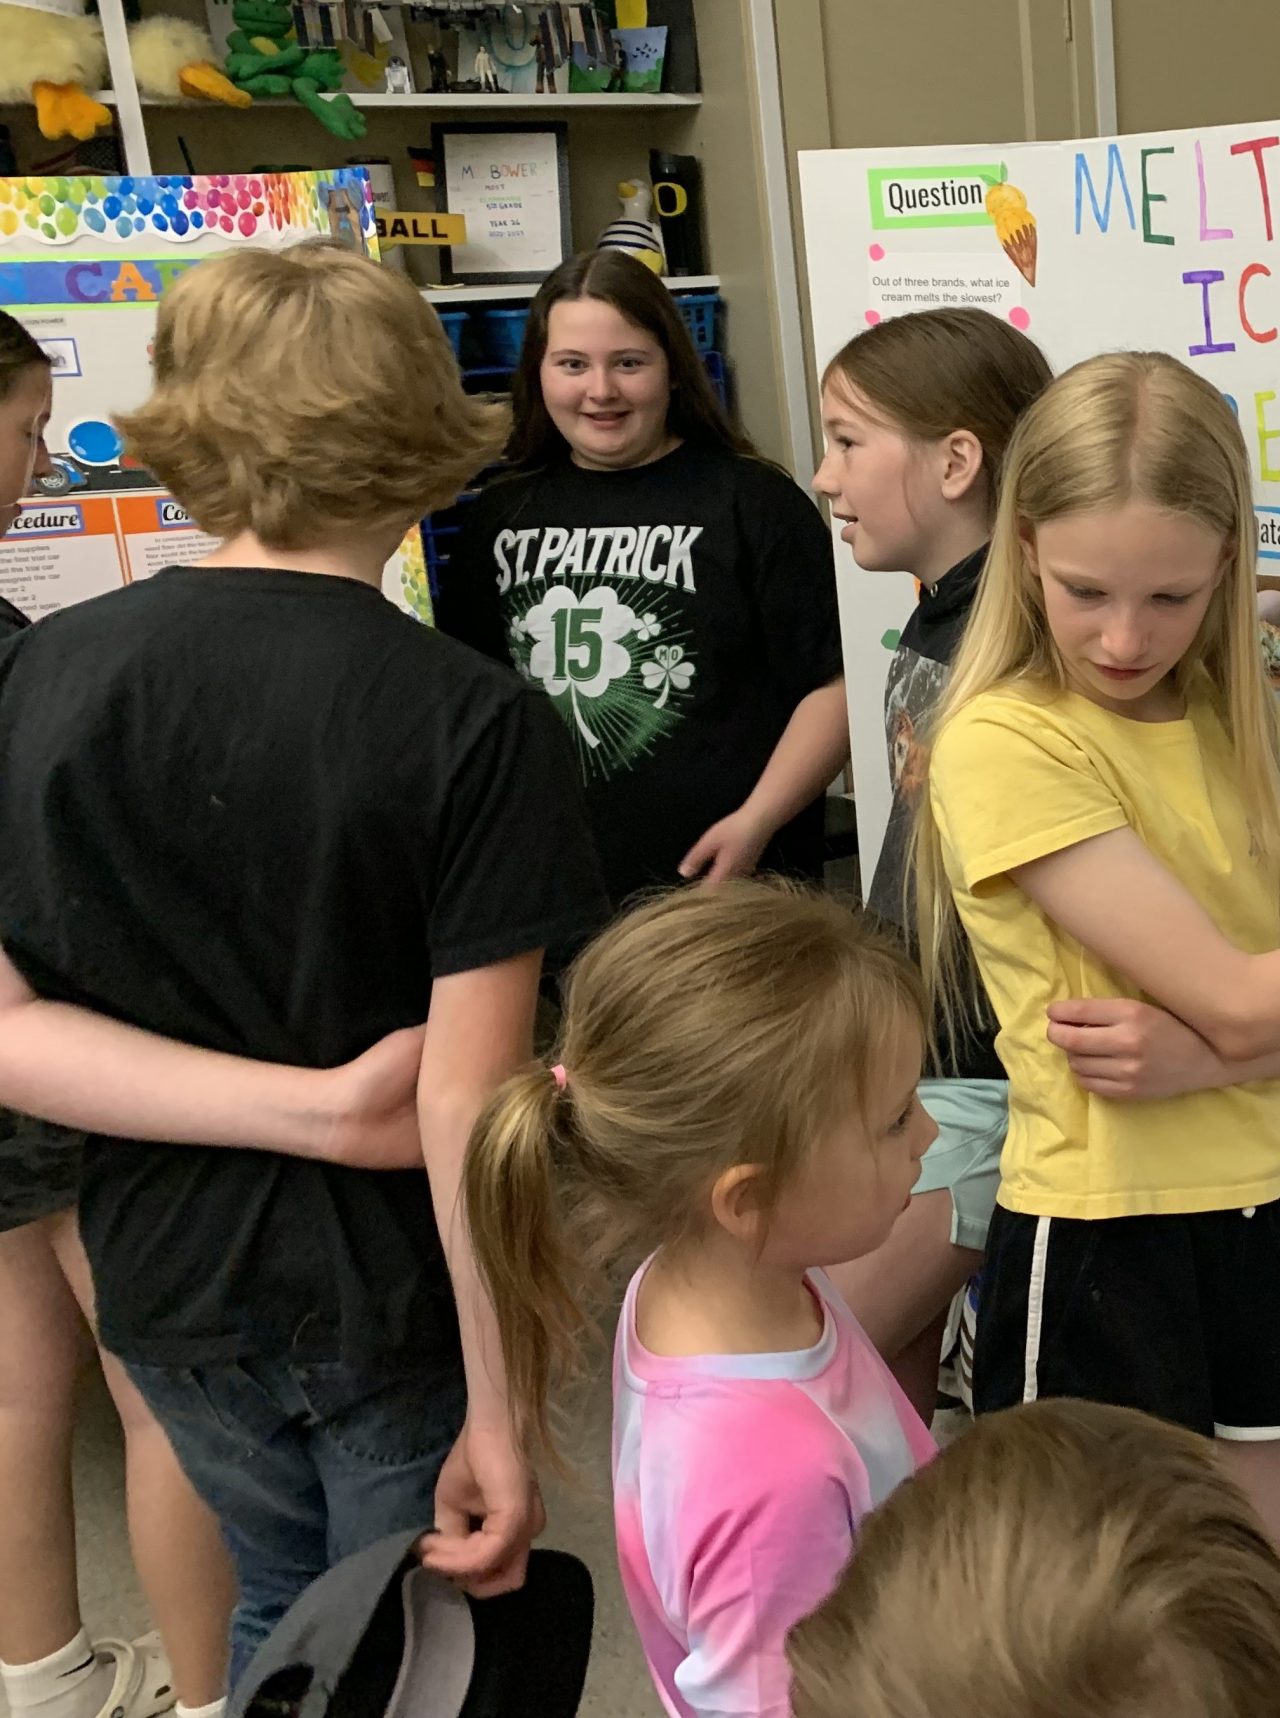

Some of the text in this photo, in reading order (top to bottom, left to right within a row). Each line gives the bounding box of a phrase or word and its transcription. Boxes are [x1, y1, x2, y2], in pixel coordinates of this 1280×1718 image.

[889, 180, 982, 213] Question
[872, 276, 890, 286] Out
[892, 277, 902, 286] of
[904, 277, 929, 286] three
[970, 278, 993, 287] what
[996, 280, 1009, 288] ice
[914, 293, 940, 302] melts
[942, 293, 958, 302] the
[960, 293, 1002, 302] slowest?
[8, 512, 78, 530] cedure
[550, 607, 603, 681] 15
